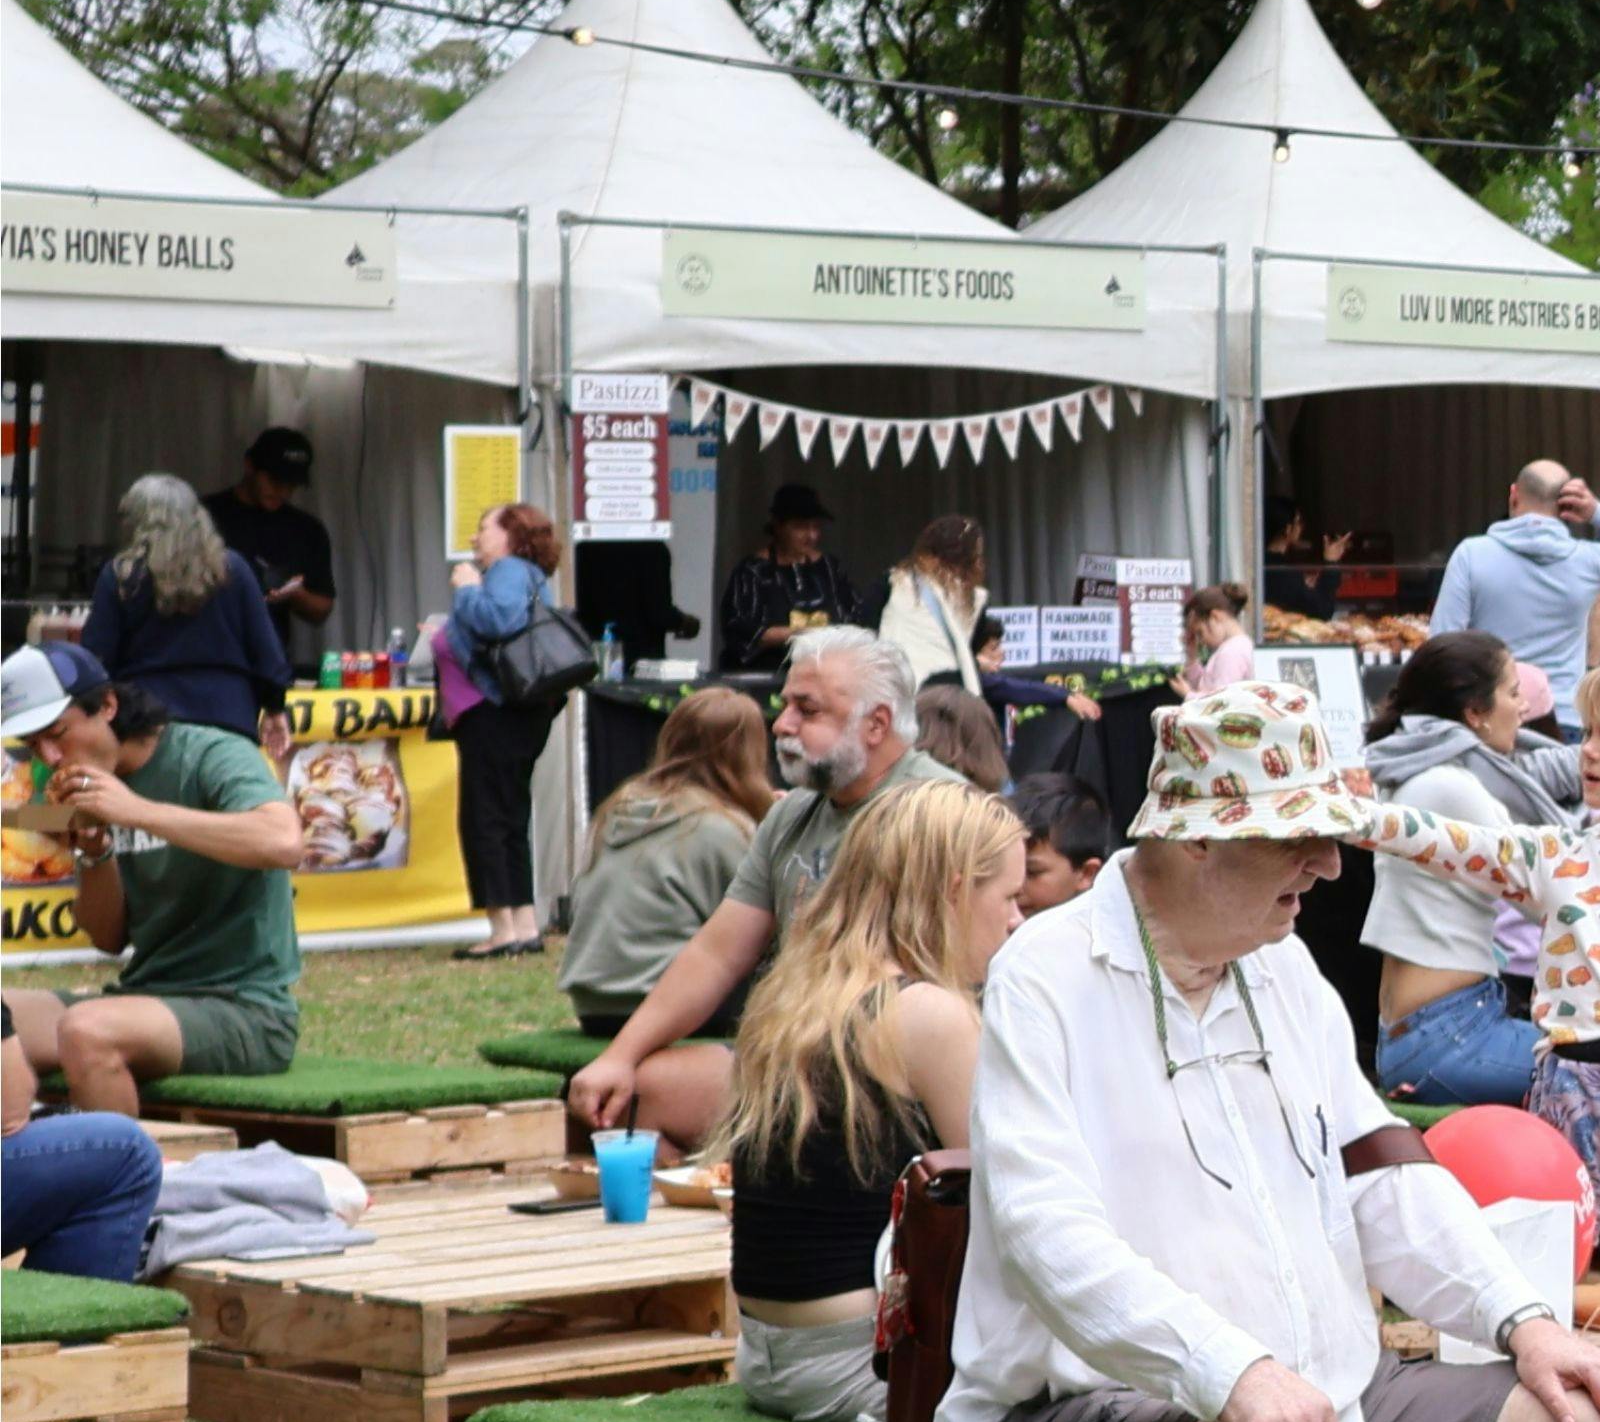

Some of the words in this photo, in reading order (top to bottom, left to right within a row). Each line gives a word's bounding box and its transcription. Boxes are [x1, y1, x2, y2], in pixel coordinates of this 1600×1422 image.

[65, 230, 149, 268] HONEY
[157, 234, 235, 272] BALLS
[812, 263, 950, 298] ANTOINETTE'S
[955, 269, 1016, 301] FOODS
[1400, 294, 1432, 322] LUV
[1435, 296, 1446, 323] U
[1450, 297, 1494, 326] MORE
[1500, 300, 1571, 329] PASTRIES
[1575, 305, 1585, 328] &
[579, 379, 660, 401] Pastizzi
[582, 415, 609, 440] $5
[611, 416, 658, 439] each
[1125, 563, 1184, 577] Pastizzi
[1128, 585, 1146, 600] $5
[1148, 585, 1183, 600] each
[1045, 612, 1113, 625] HANDMADE
[1050, 631, 1108, 643] MALTESE
[1051, 648, 1110, 662] PASTIZZI
[334, 695, 432, 738] BALL
